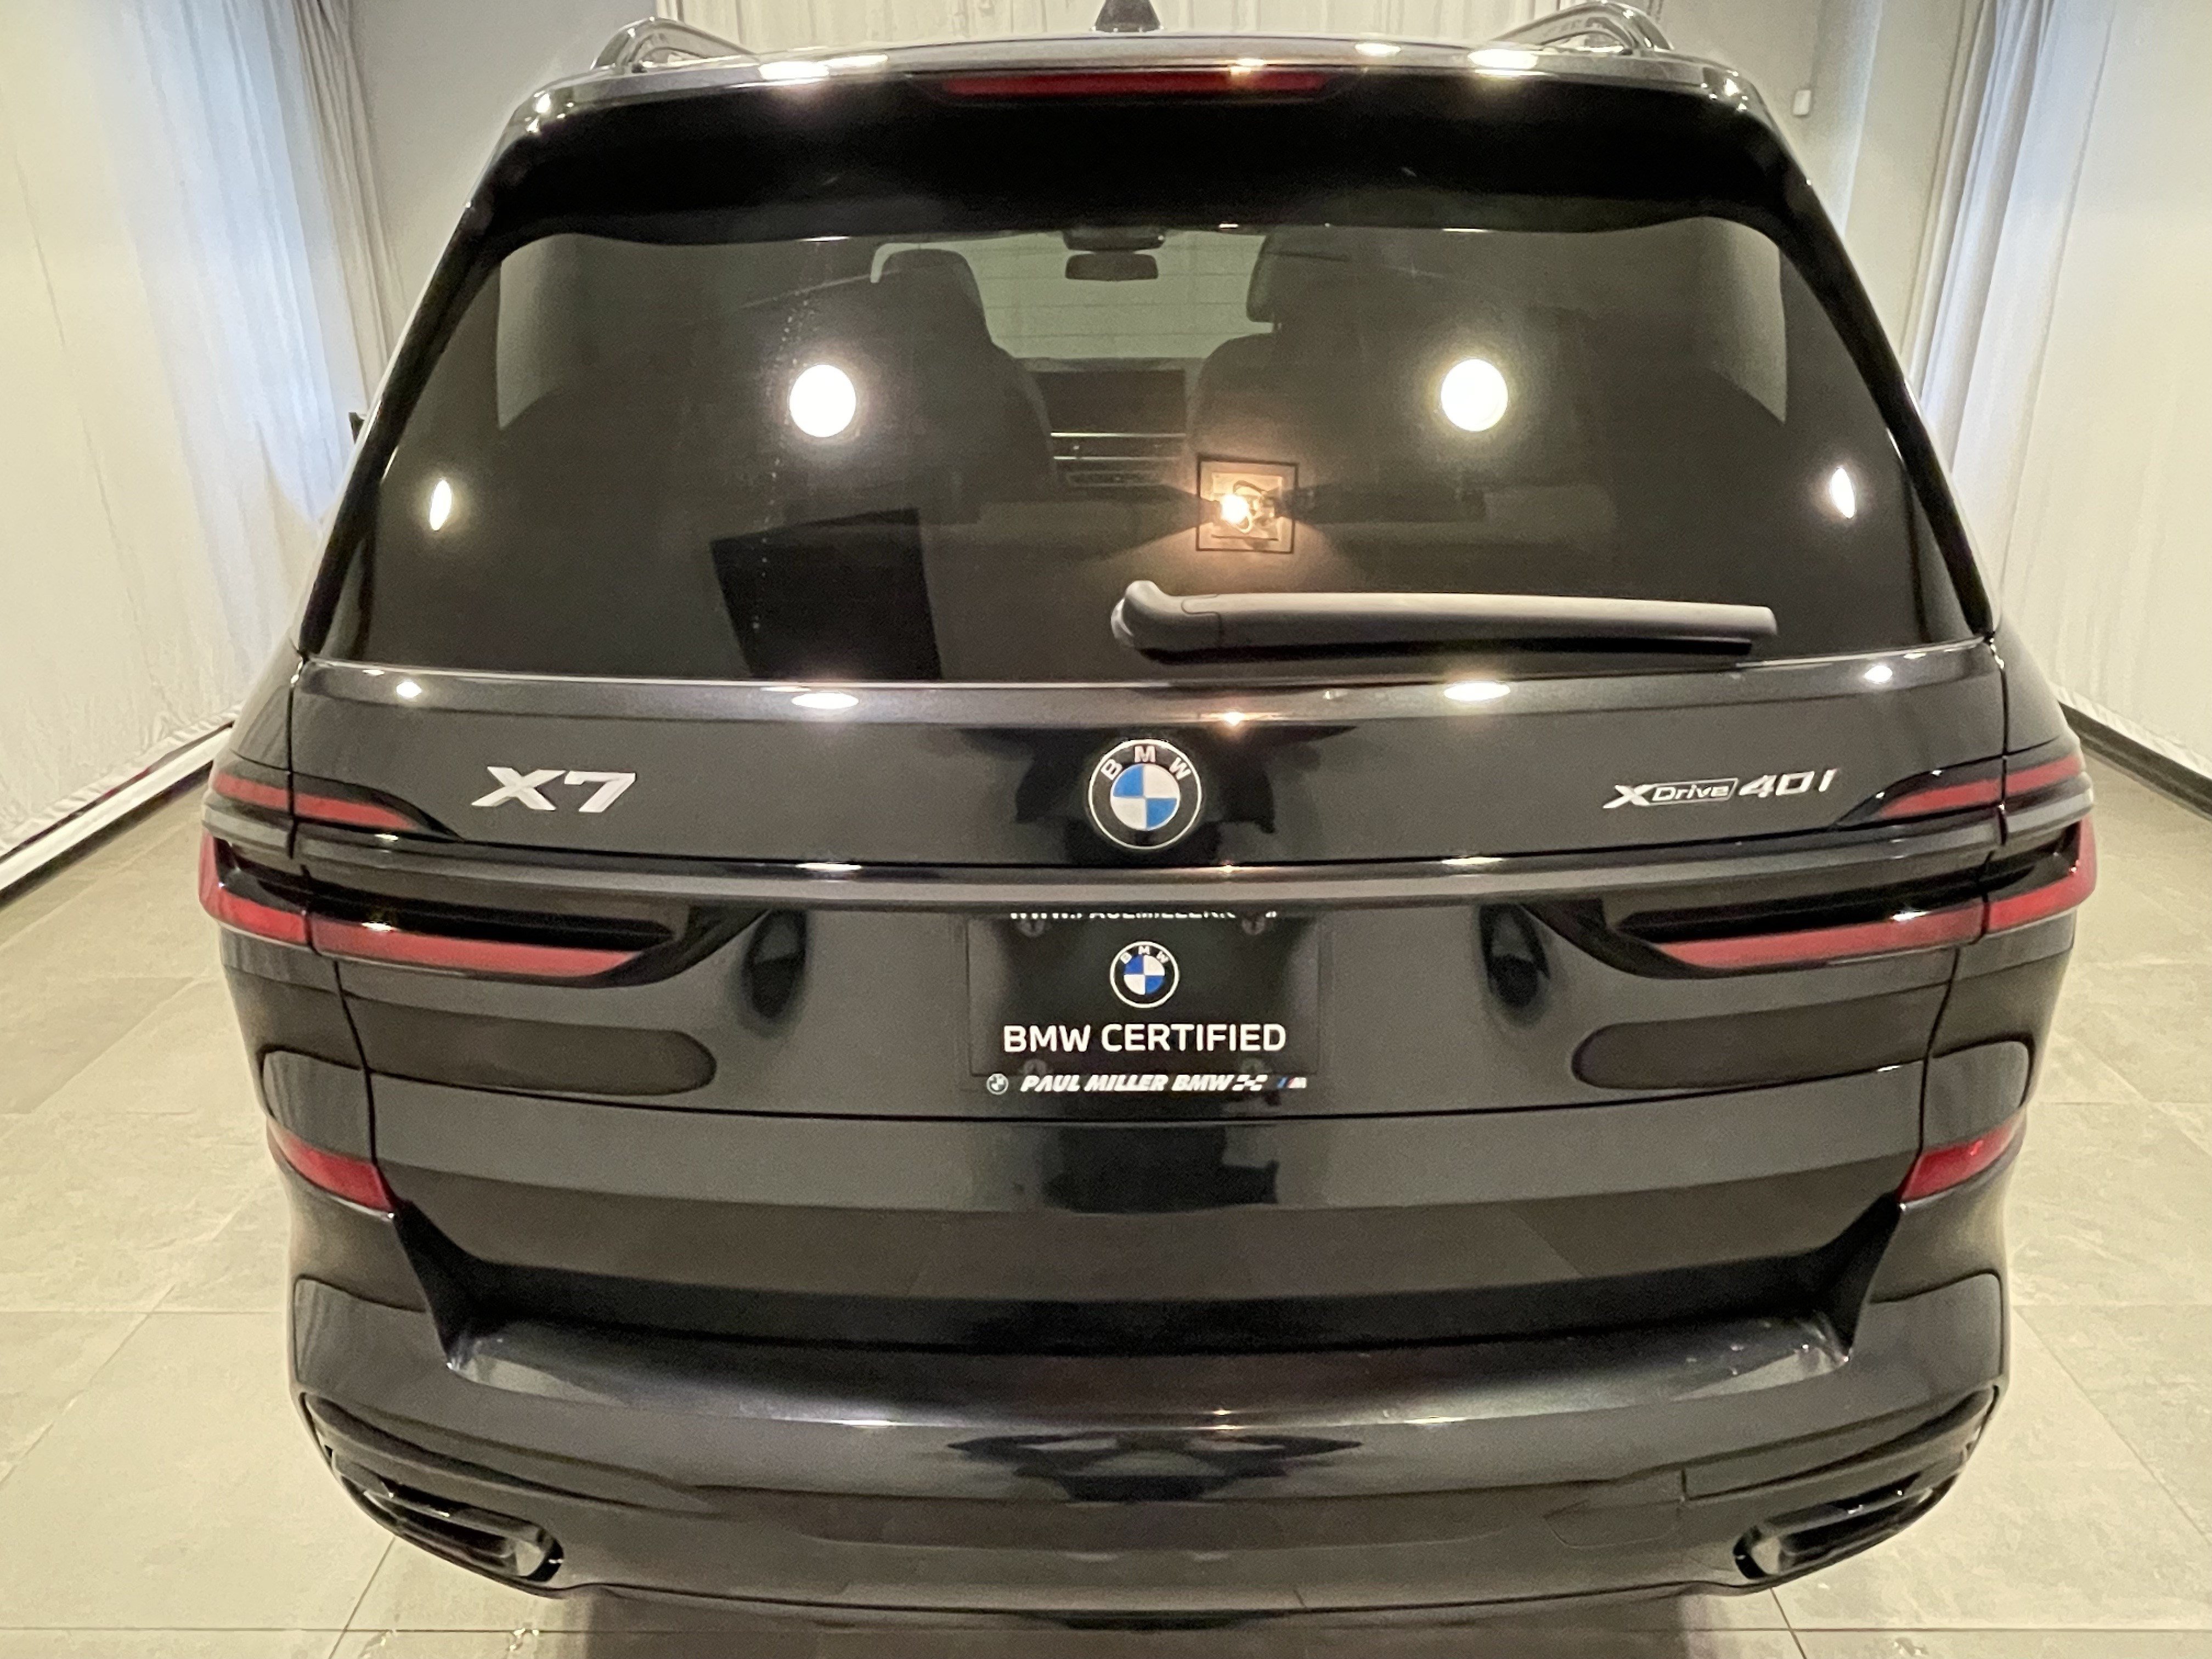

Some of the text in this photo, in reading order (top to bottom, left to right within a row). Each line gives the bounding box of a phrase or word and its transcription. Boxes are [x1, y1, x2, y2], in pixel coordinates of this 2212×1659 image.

[1101, 745, 1191, 780] BMW
[471, 766, 637, 814] X7
[1120, 945, 1169, 964] BMW
[1004, 1023, 1286, 1053] BMW CERTIFIED
[1020, 1074, 1080, 1092] PAUL
[1084, 1074, 1169, 1092] MILLER
[1171, 1074, 1234, 1092] BMW
